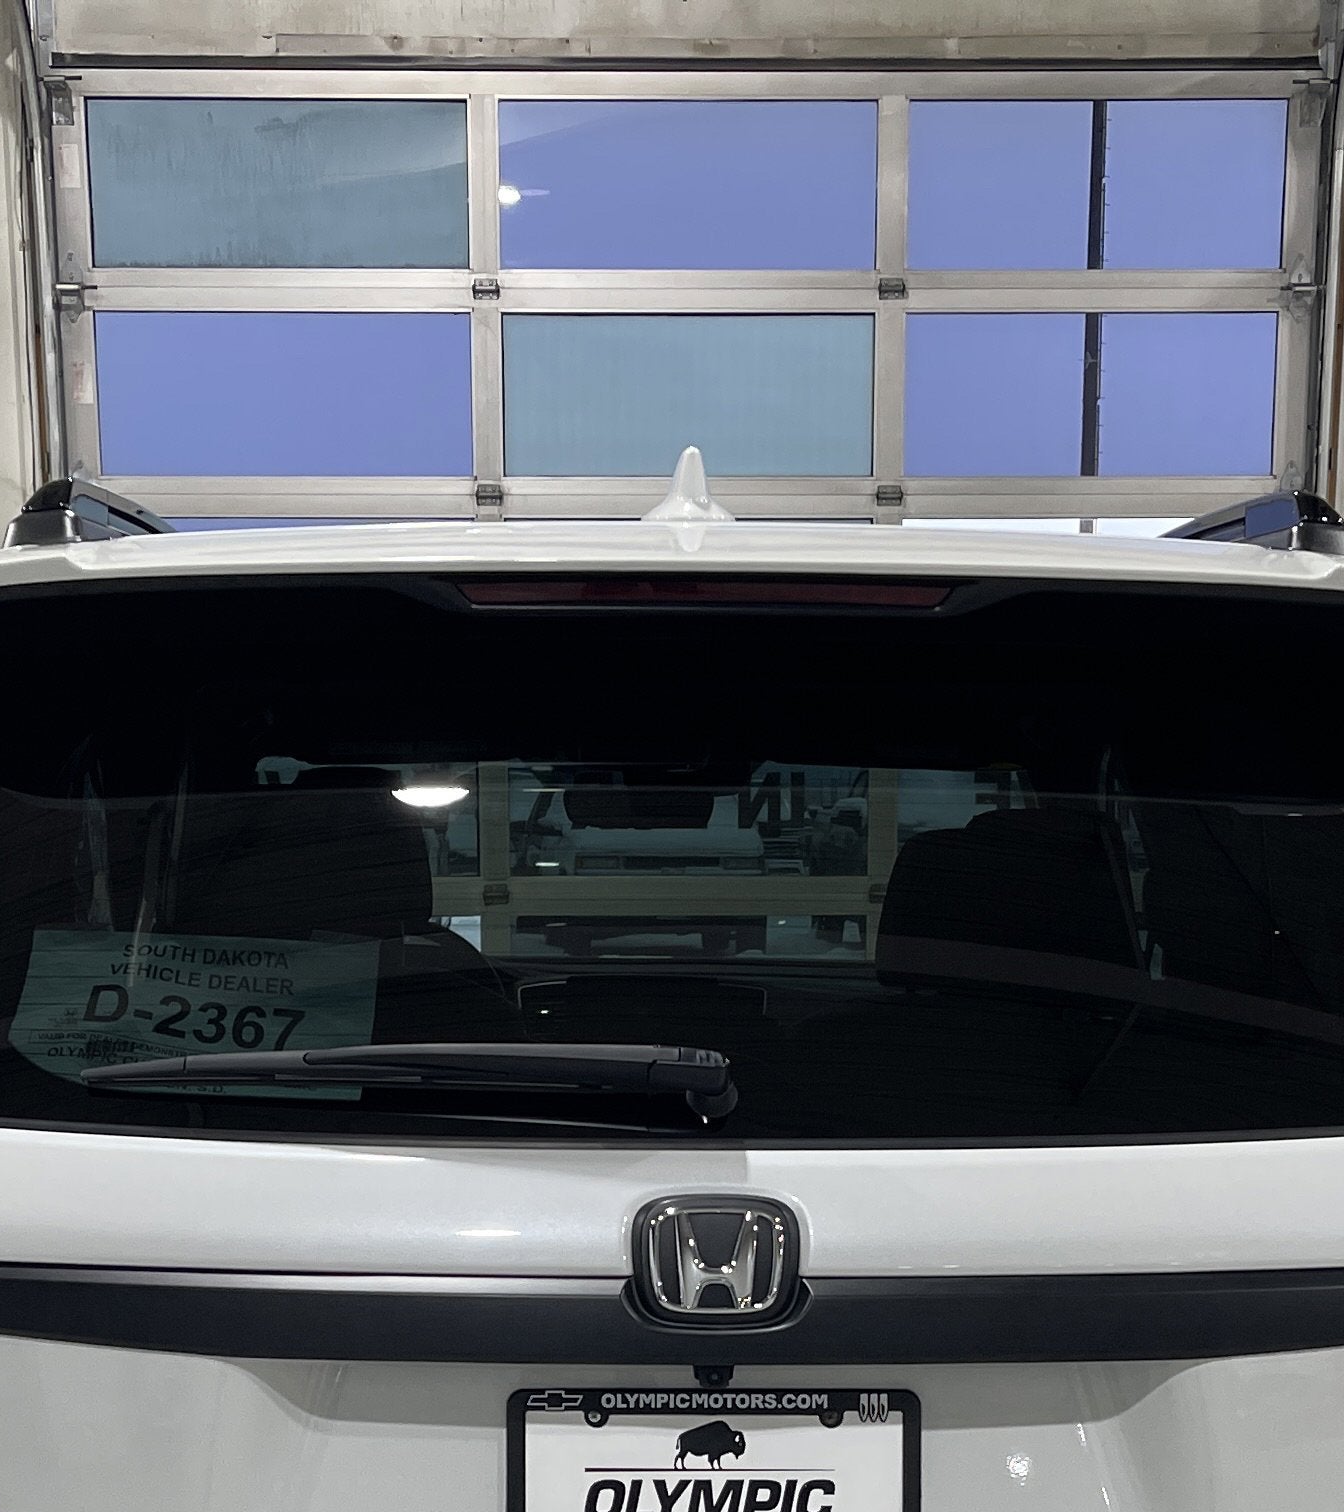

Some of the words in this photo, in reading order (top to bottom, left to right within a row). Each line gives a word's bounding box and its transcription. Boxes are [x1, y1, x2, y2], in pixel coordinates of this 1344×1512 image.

[123, 943, 196, 964] SOUTH
[202, 948, 289, 970] DAKOTA
[110, 963, 200, 987] VEHICLE
[208, 974, 294, 996] DEALER
[83, 984, 306, 1051] D-2367
[601, 1393, 829, 1410] OLYMPICMOTORS.COM
